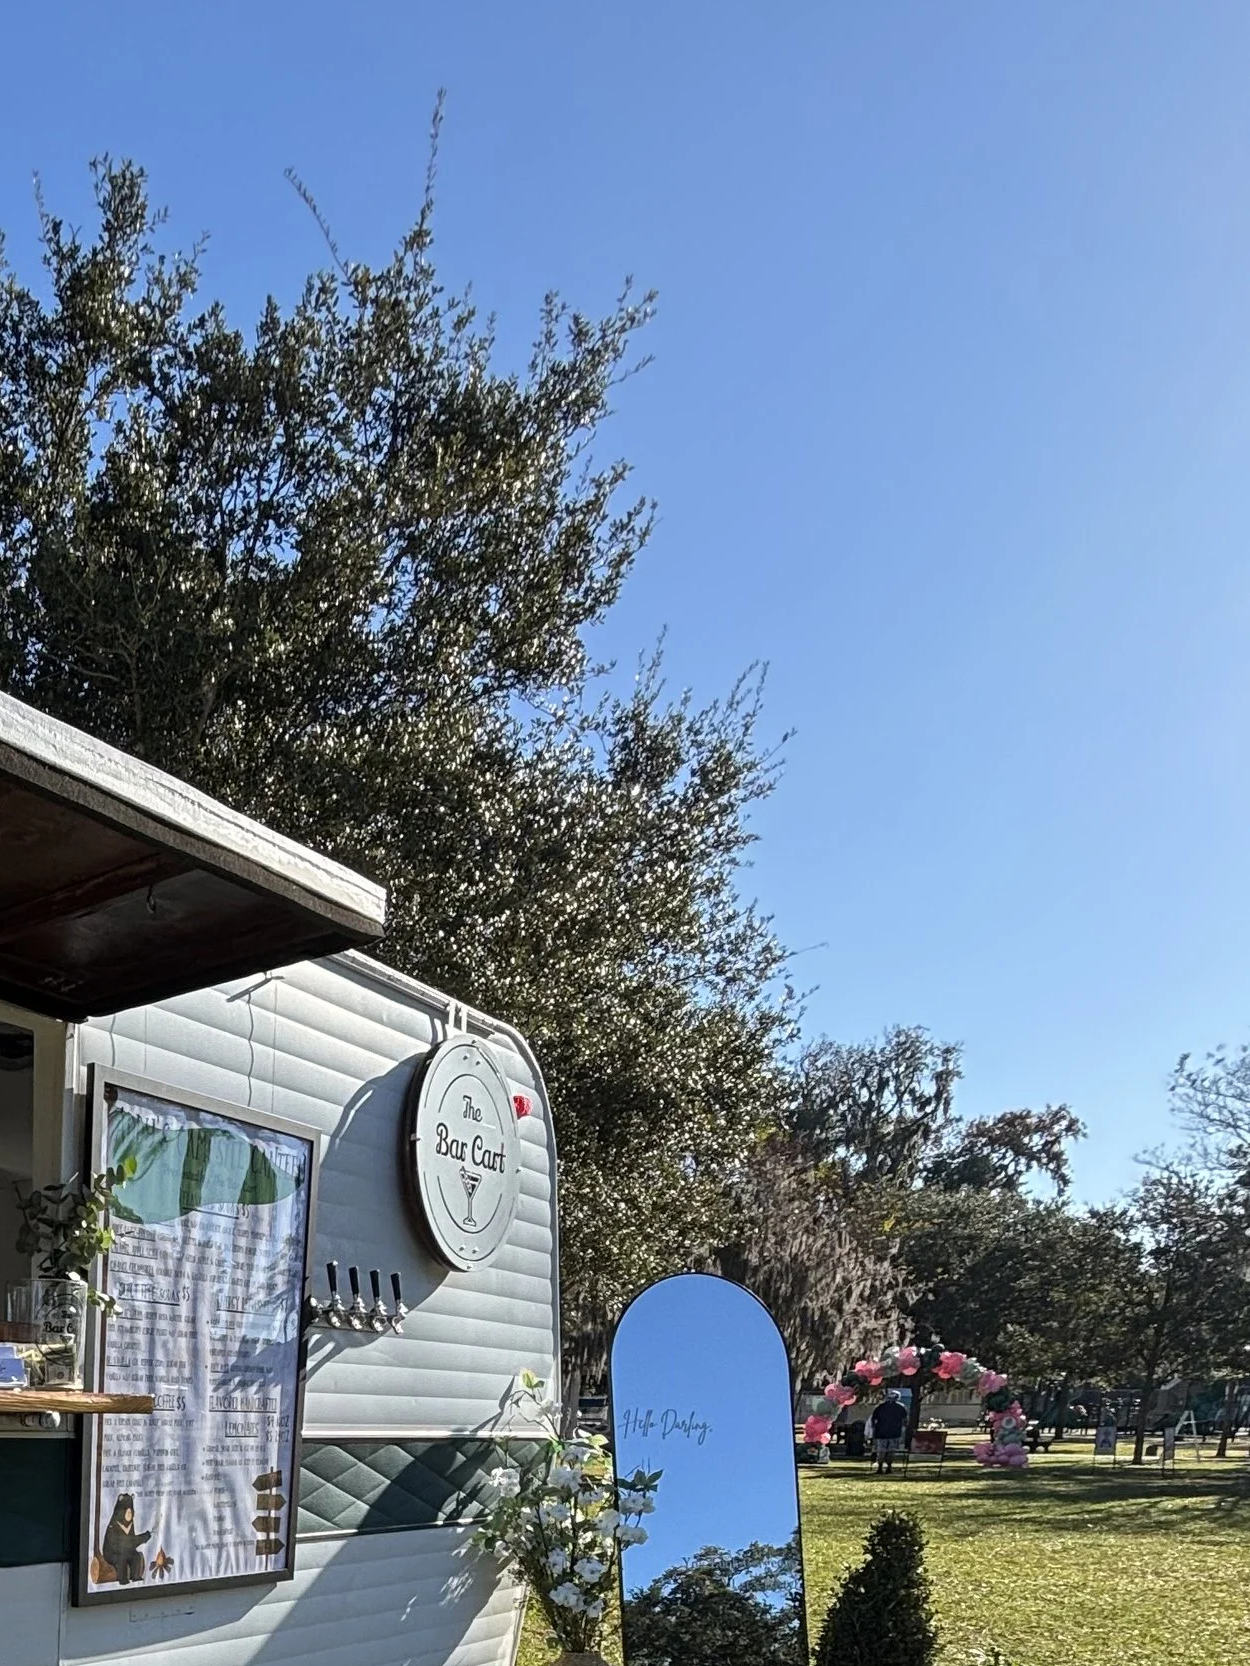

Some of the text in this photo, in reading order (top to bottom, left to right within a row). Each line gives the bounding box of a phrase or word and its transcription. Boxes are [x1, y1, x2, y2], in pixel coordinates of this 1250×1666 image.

[462, 1094, 483, 1123] The
[435, 1122, 507, 1174] Bar Cart
[43, 1321, 65, 1334] Bar
[618, 1407, 713, 1447] Hello Darling.
